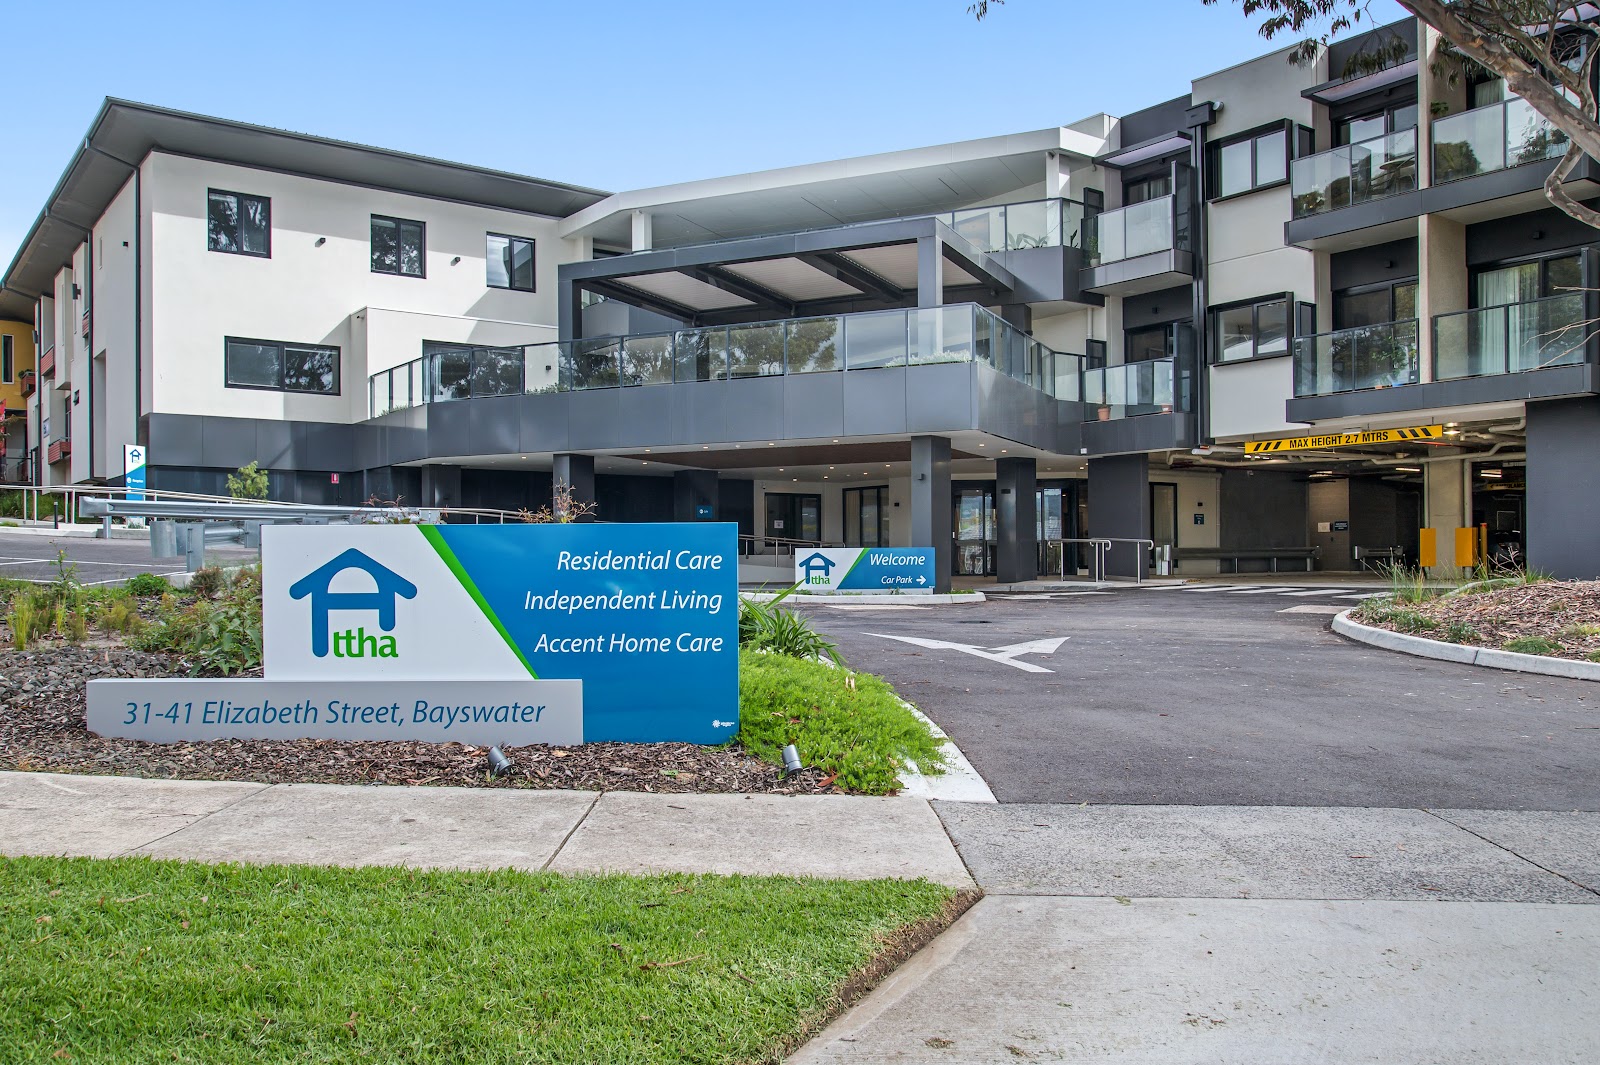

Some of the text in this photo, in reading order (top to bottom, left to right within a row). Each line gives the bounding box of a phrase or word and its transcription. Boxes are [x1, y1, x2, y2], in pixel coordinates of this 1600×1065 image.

[1289, 431, 1389, 449] MAX HEIGHT 2.7 MTRS
[557, 549, 723, 571] Residential Care
[870, 553, 926, 566] Welcome
[811, 575, 831, 585] ttha
[881, 575, 913, 584] Car Park
[524, 589, 723, 615] Independent Living
[332, 627, 399, 658] ttha
[533, 632, 724, 653] Accent Home Care
[123, 699, 546, 730] 31-41 Elizabeth Street, Bayswater
